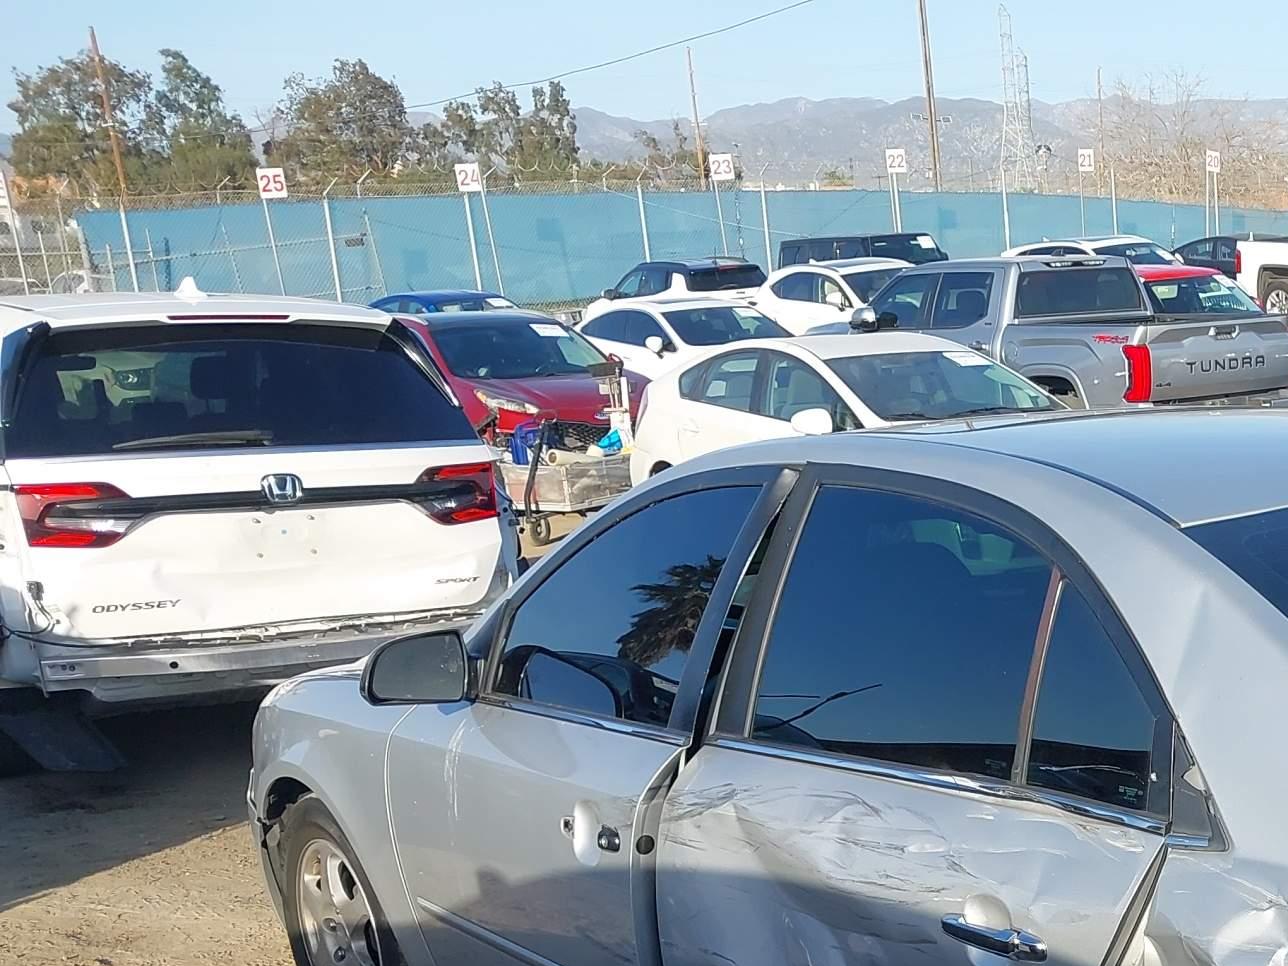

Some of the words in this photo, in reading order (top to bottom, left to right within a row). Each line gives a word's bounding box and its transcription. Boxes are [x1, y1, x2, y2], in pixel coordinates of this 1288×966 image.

[711, 159, 732, 175] 23
[888, 154, 904, 168] 22
[1079, 154, 1093, 167] 21
[1208, 154, 1219, 168] 20
[260, 174, 284, 193] 25
[458, 169, 481, 186] 24
[1185, 355, 1265, 374] TUNDRA
[434, 576, 481, 585] SPORT
[92, 599, 182, 614] ODYSSEY
